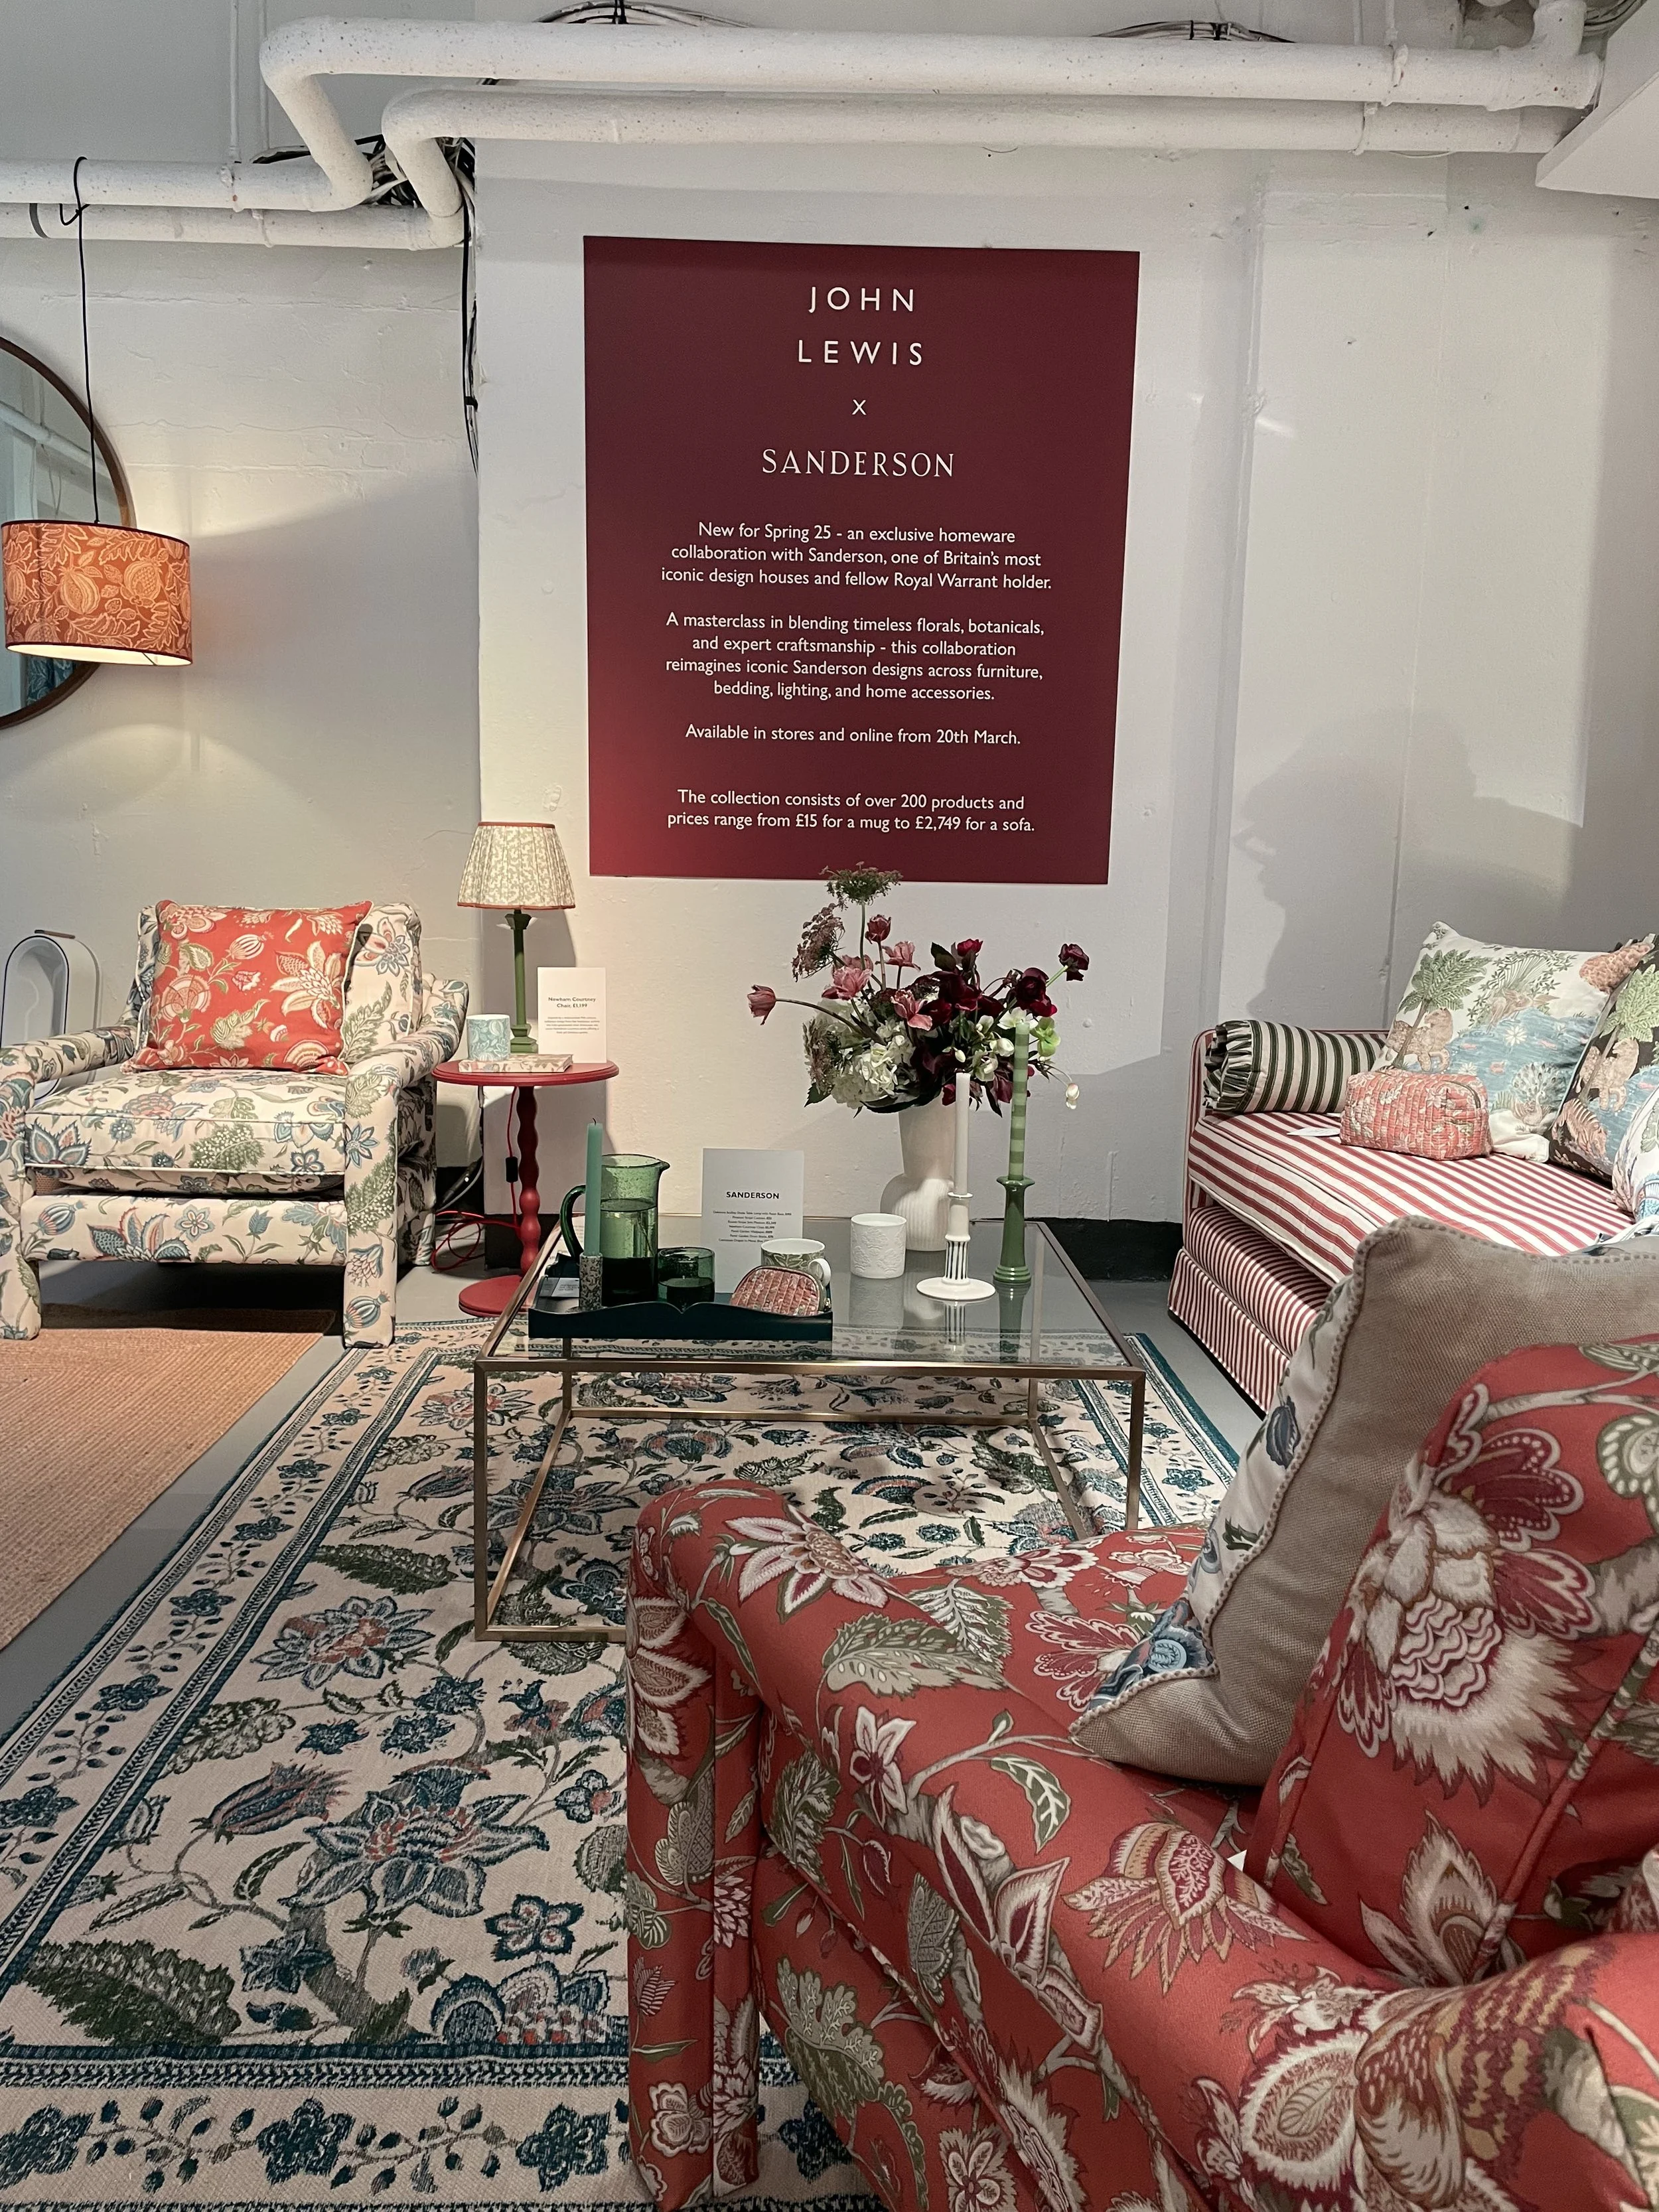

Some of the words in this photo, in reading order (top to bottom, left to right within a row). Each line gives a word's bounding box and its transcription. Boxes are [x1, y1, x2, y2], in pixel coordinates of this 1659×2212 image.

[808, 286, 914, 313] JOHN
[798, 339, 922, 366] LEWIS
[762, 449, 954, 477] SANDERSON
[699, 521, 735, 537] New
[739, 522, 760, 538] for
[764, 523, 810, 544] Spring
[814, 524, 831, 540] 25
[847, 530, 864, 540] an
[869, 526, 934, 542] exclusive
[939, 527, 1015, 543] homeware
[671, 544, 766, 561] collaboration
[770, 547, 804, 561] with
[808, 547, 887, 565] Sanderson,
[891, 553, 918, 564] one
[923, 550, 940, 565] of
[944, 550, 999, 565] Britain's
[1005, 553, 1042, 566] most
[662, 567, 704, 582] iconic
[709, 567, 754, 587] design
[759, 569, 810, 585] houses
[814, 571, 840, 585] and
[845, 571, 889, 586] fellow
[894, 571, 933, 591] Royal
[937, 573, 999, 588] Warrant
[1003, 573, 1052, 589] holder.
[666, 611, 679, 627] A
[684, 613, 766, 628] masterclass
[770, 615, 783, 629] in
[788, 615, 849, 634] blending
[853, 617, 912, 632] timeless
[916, 617, 964, 634] florals,
[968, 618, 1045, 636] botanicals,
[692, 635, 719, 650] and
[723, 638, 772, 654] expert
[776, 637, 875, 658] craftsmanship
[891, 639, 917, 654] this
[922, 640, 1016, 656] collaboration
[666, 658, 741, 676] reimagines
[747, 659, 788, 674] iconic
[793, 659, 867, 676] Sanderson
[872, 661, 923, 680] designs
[928, 666, 972, 678] across
[976, 663, 1043, 680] furniture,
[714, 680, 774, 700] bedding,
[777, 682, 831, 701] lighting,
[835, 683, 861, 698] and
[865, 683, 907, 698] home
[911, 686, 995, 700] accessories.
[685, 723, 749, 739] Available
[754, 726, 766, 739] in
[771, 727, 814, 741] stores
[819, 727, 845, 741] and
[849, 727, 893, 743] online
[897, 728, 931, 743] from
[936, 729, 969, 744] 20th
[974, 729, 1021, 745] March.
[677, 788, 706, 804] The
[710, 790, 780, 805] collection
[784, 793, 841, 806] consists
[845, 792, 861, 807] of
[865, 797, 897, 808] over
[901, 794, 927, 808] 200
[931, 794, 994, 812] products
[999, 796, 1025, 810] and
[668, 811, 709, 829] prices
[714, 816, 753, 830] range
[757, 812, 790, 827] from
[795, 813, 818, 828] £15
[822, 814, 843, 828] for
[847, 818, 855, 828] a
[860, 818, 891, 833] mug
[894, 817, 910, 830] to
[914, 816, 961, 832] £2,749
[965, 816, 986, 831] for
[989, 821, 998, 831] a
[1002, 817, 1035, 832] sofa.
